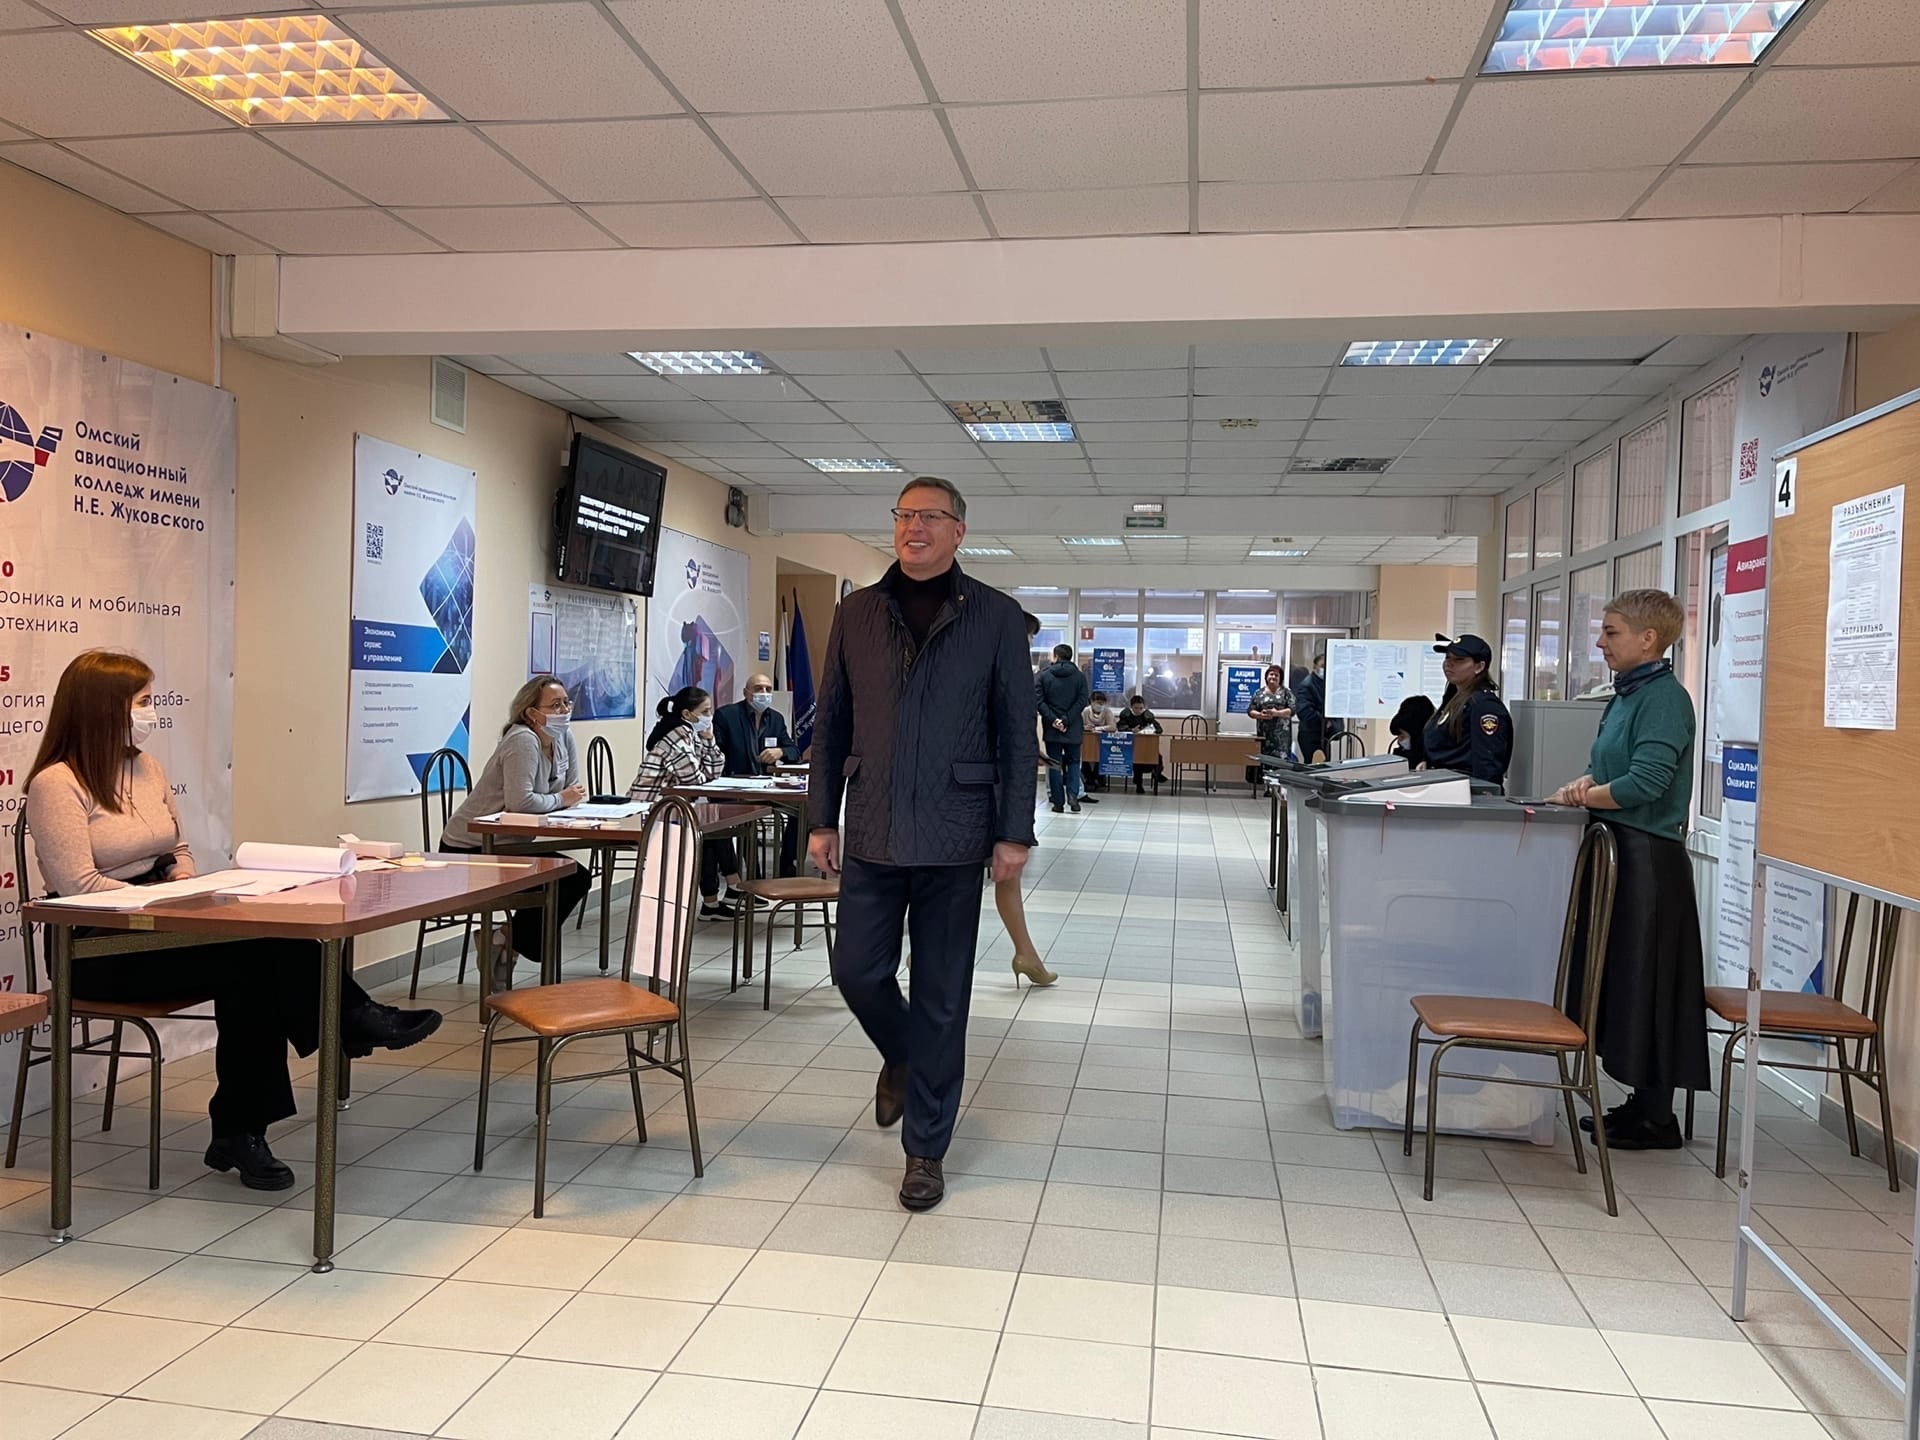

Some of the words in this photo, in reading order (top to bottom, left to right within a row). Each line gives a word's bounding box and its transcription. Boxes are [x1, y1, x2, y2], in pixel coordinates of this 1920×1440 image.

[75, 421, 140, 451] Омский
[74, 449, 187, 484] авиационный
[74, 474, 145, 499] колледж
[150, 489, 200, 509] имени
[1778, 469, 1791, 508] 4
[74, 495, 104, 516] Н.Е.
[111, 501, 205, 531] Жуковского
[71, 597, 82, 609] и
[89, 596, 181, 616] мобильная
[367, 654, 403, 663] управление
